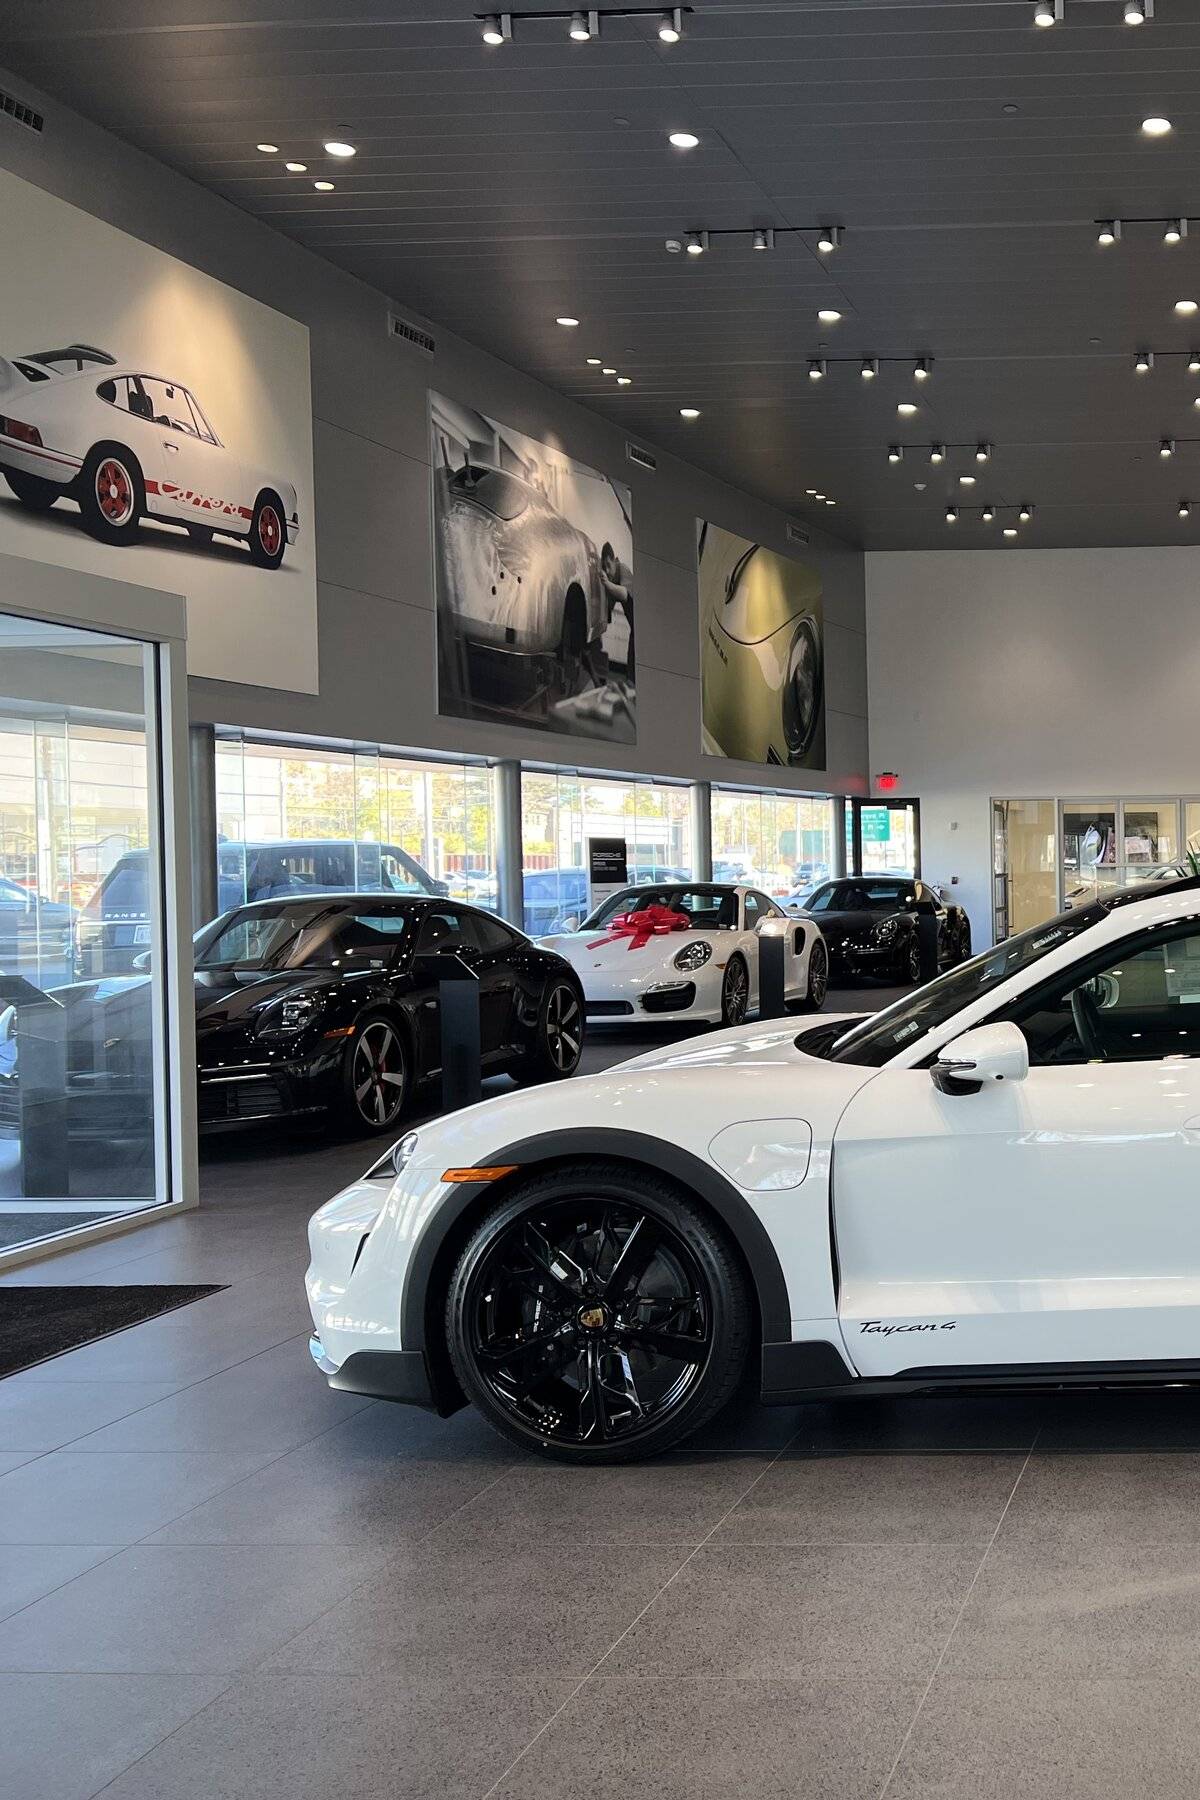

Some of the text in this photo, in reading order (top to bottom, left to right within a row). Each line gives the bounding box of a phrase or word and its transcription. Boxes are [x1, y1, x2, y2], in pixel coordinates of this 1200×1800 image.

[158, 479, 243, 519] Carrera
[859, 1320, 957, 1338] Taycan 4
